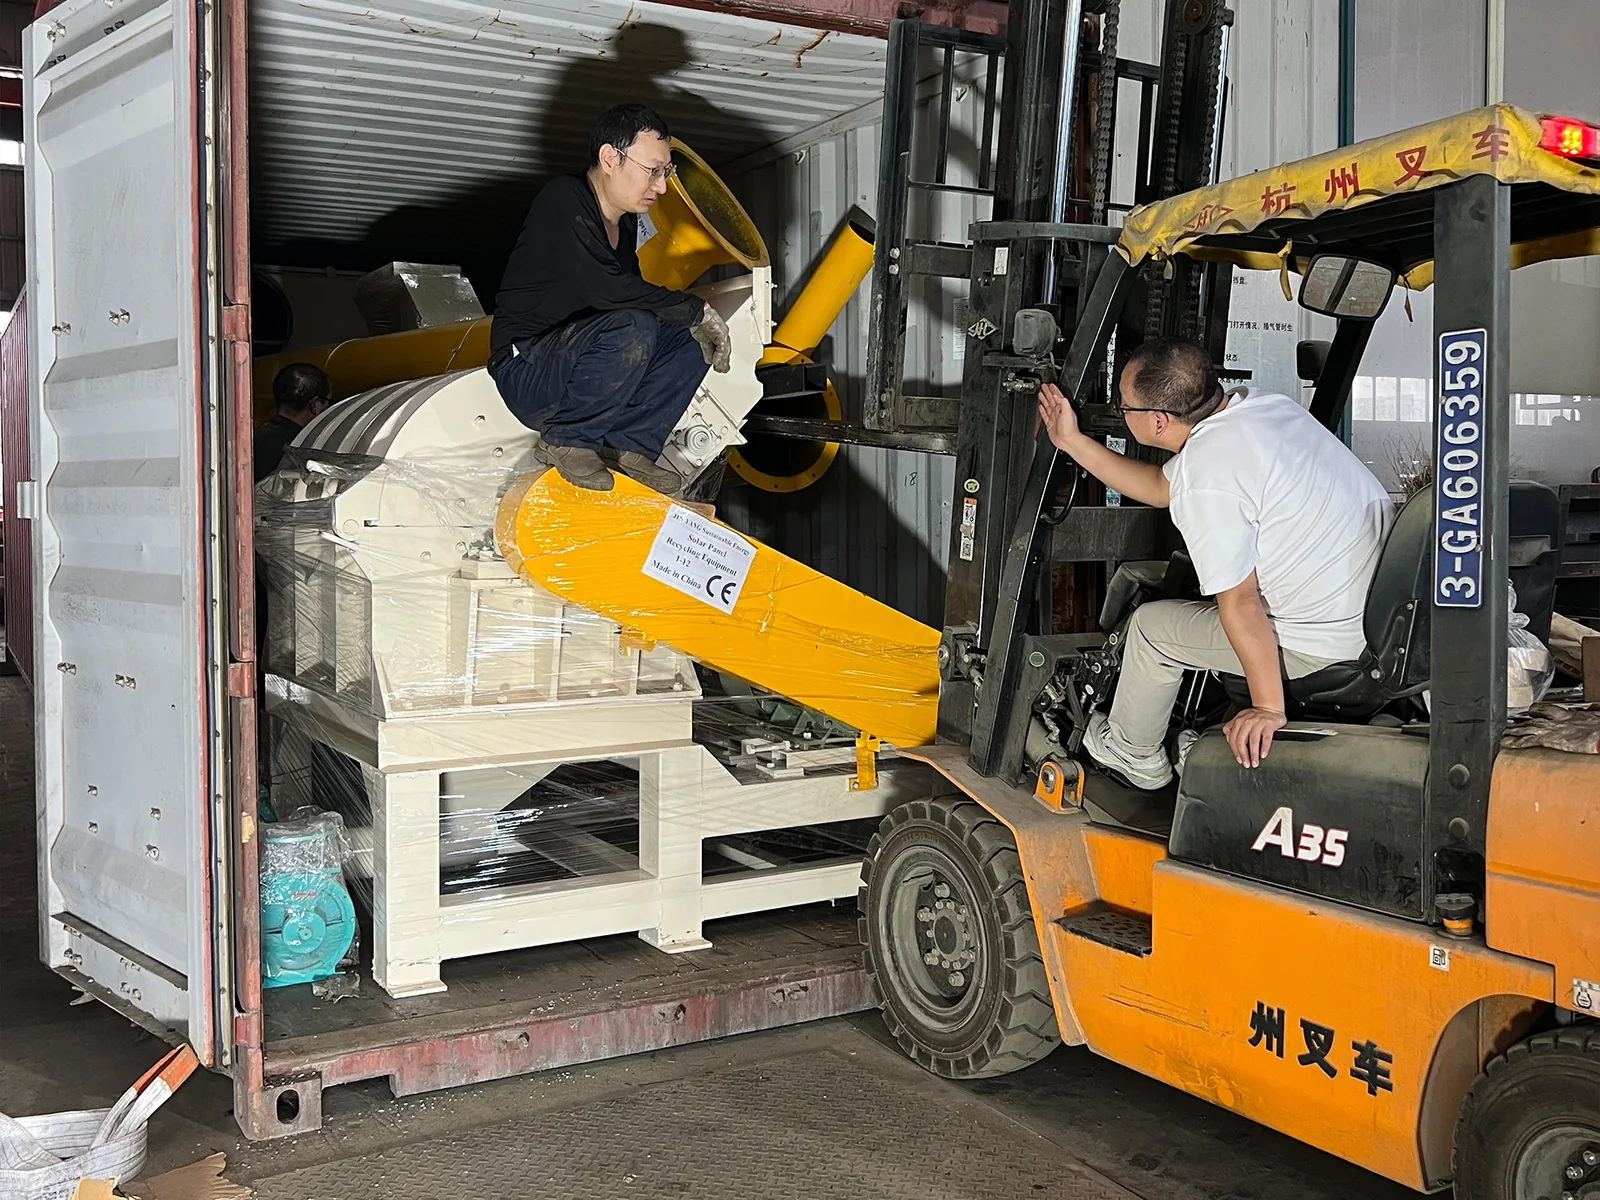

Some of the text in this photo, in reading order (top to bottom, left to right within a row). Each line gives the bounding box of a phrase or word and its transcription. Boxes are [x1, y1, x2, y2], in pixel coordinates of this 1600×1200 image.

[1260, 124, 1510, 215] 杭州叉车
[1440, 339, 1482, 599] 3-GA606359
[666, 536, 738, 577] Recycling Equipment
[685, 518, 702, 531] YANG
[702, 528, 733, 547] Sustainable
[732, 542, 750, 557] Energy
[687, 534, 728, 558] Solar Panel
[651, 559, 702, 590] Made in China
[705, 574, 737, 606] CE
[1250, 806, 1350, 868] A35
[1247, 1000, 1394, 1097] 州叉车
